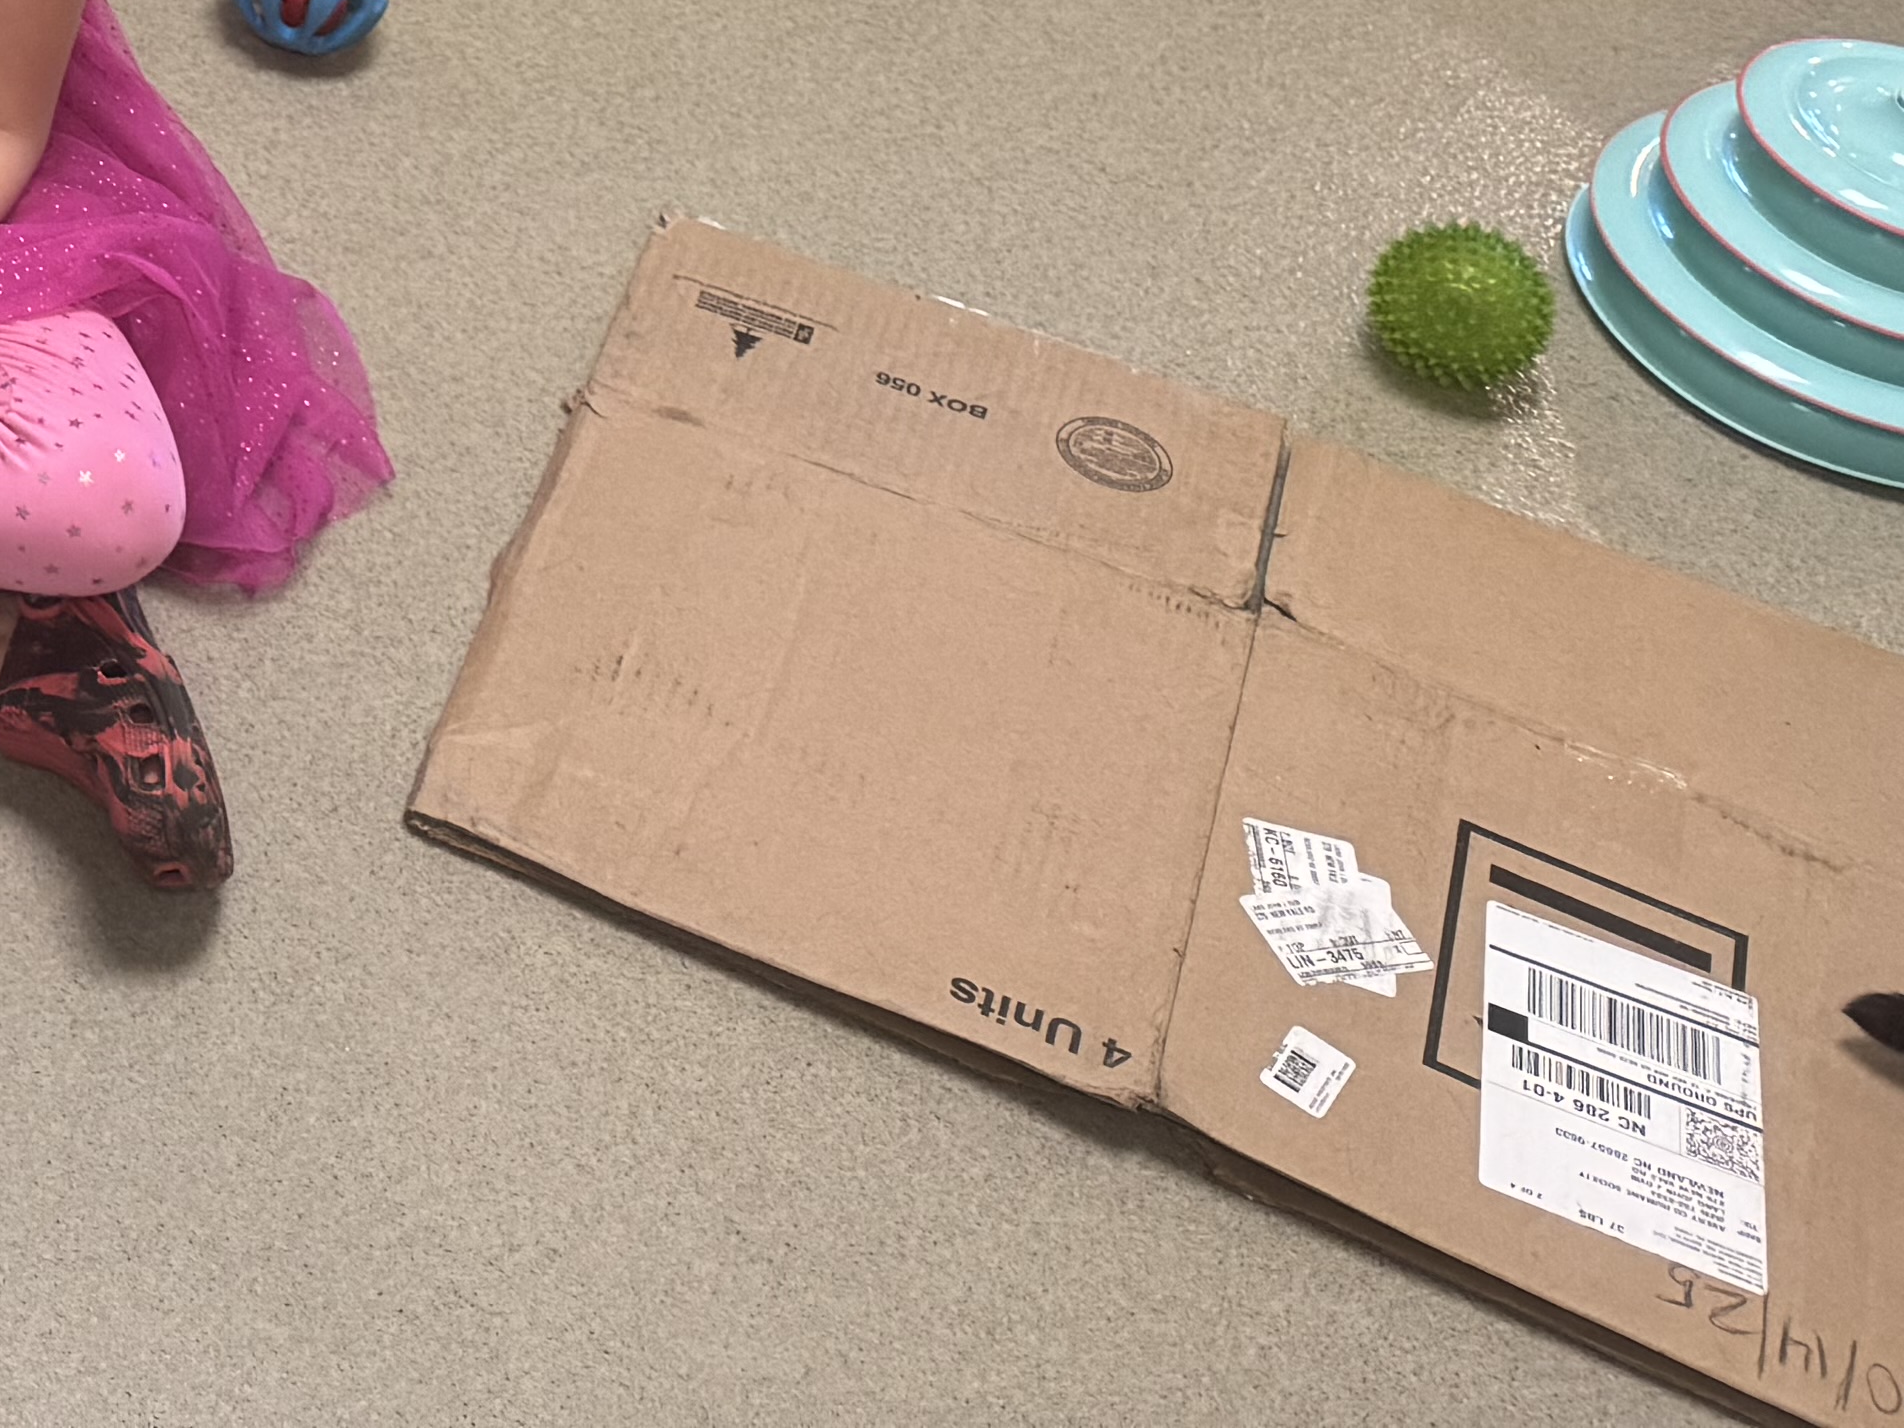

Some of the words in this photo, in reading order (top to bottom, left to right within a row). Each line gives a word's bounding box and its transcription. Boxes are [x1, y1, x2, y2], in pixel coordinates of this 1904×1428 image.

[875, 371, 921, 397] 056
[927, 390, 988, 420] BOX
[949, 976, 1083, 1056] Units
[1102, 1037, 1132, 1069] 4
[1646, 1071, 1716, 1107] GROUND
[1572, 1097, 1609, 1123] 286
[1723, 1100, 1757, 1123] UPS
[1617, 1114, 1646, 1137] NC
